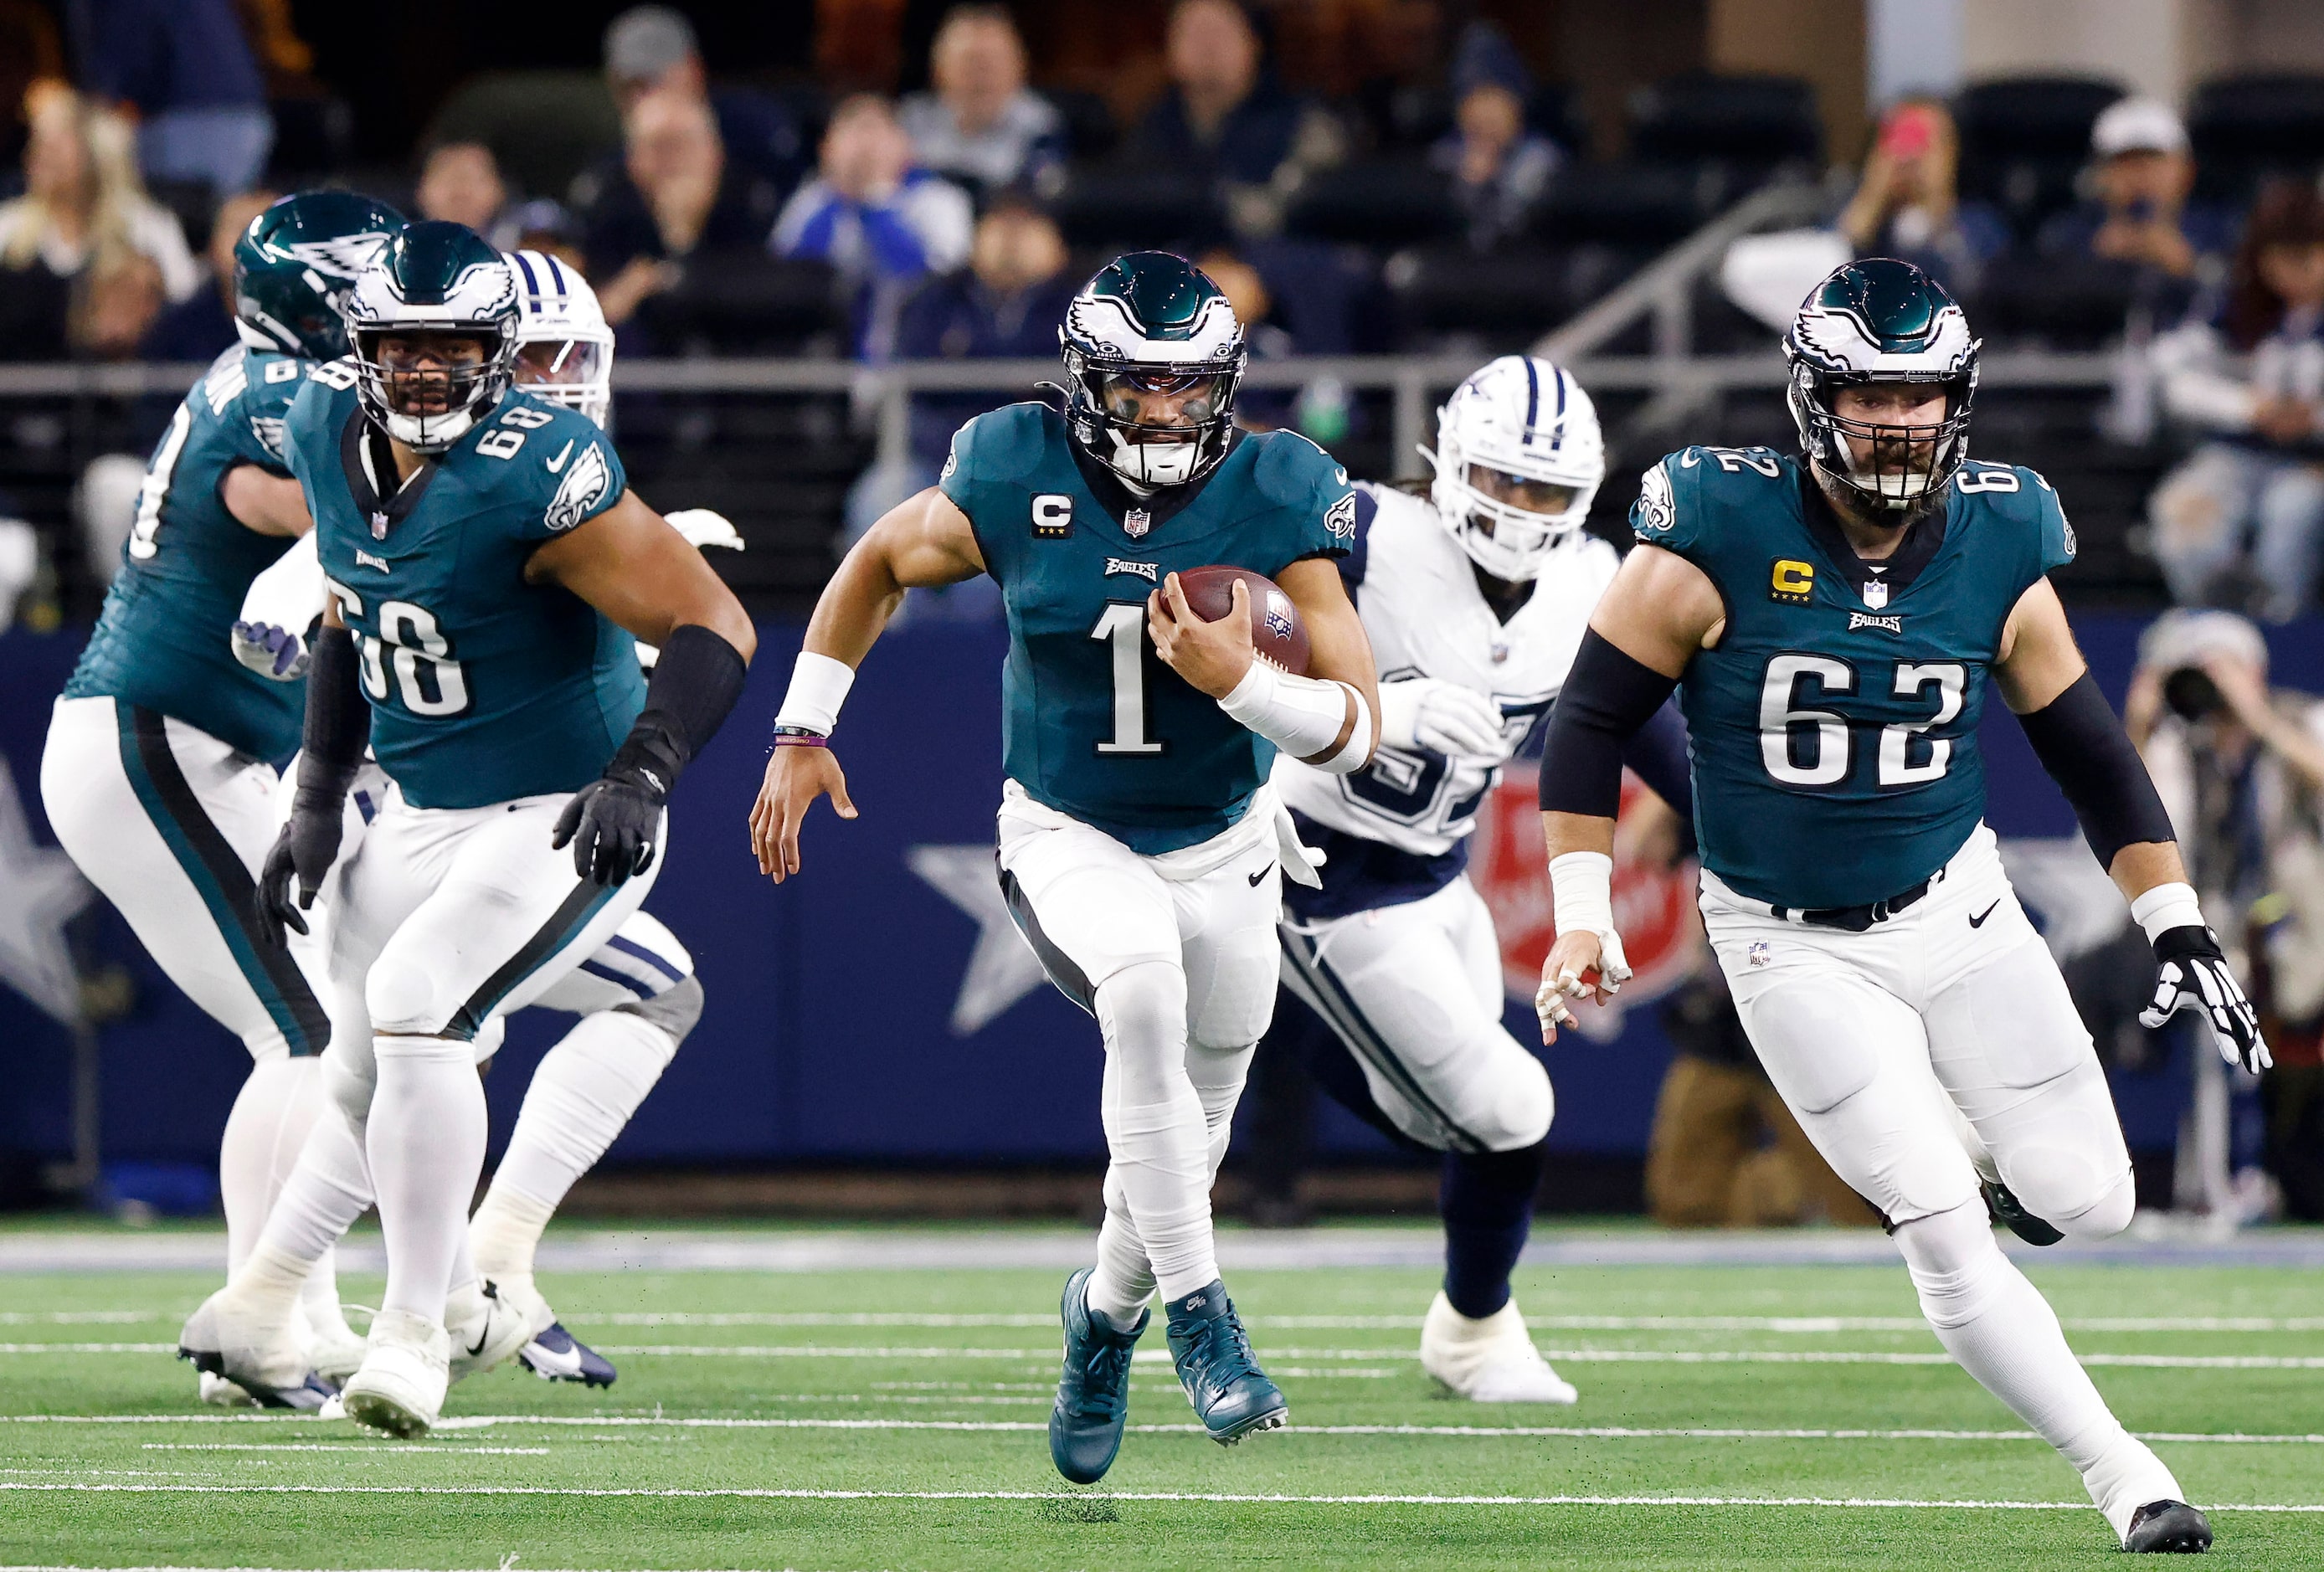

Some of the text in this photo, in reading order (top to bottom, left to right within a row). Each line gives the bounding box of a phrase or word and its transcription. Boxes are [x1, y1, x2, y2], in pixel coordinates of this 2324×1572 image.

[476, 406, 554, 460] 68
[1032, 495, 1072, 527] C
[1104, 557, 1159, 583] EAGLES
[1772, 559, 1813, 594] C
[1848, 612, 1902, 634] EAGLES
[1090, 604, 1162, 753] 1
[1759, 655, 1965, 786] 62
